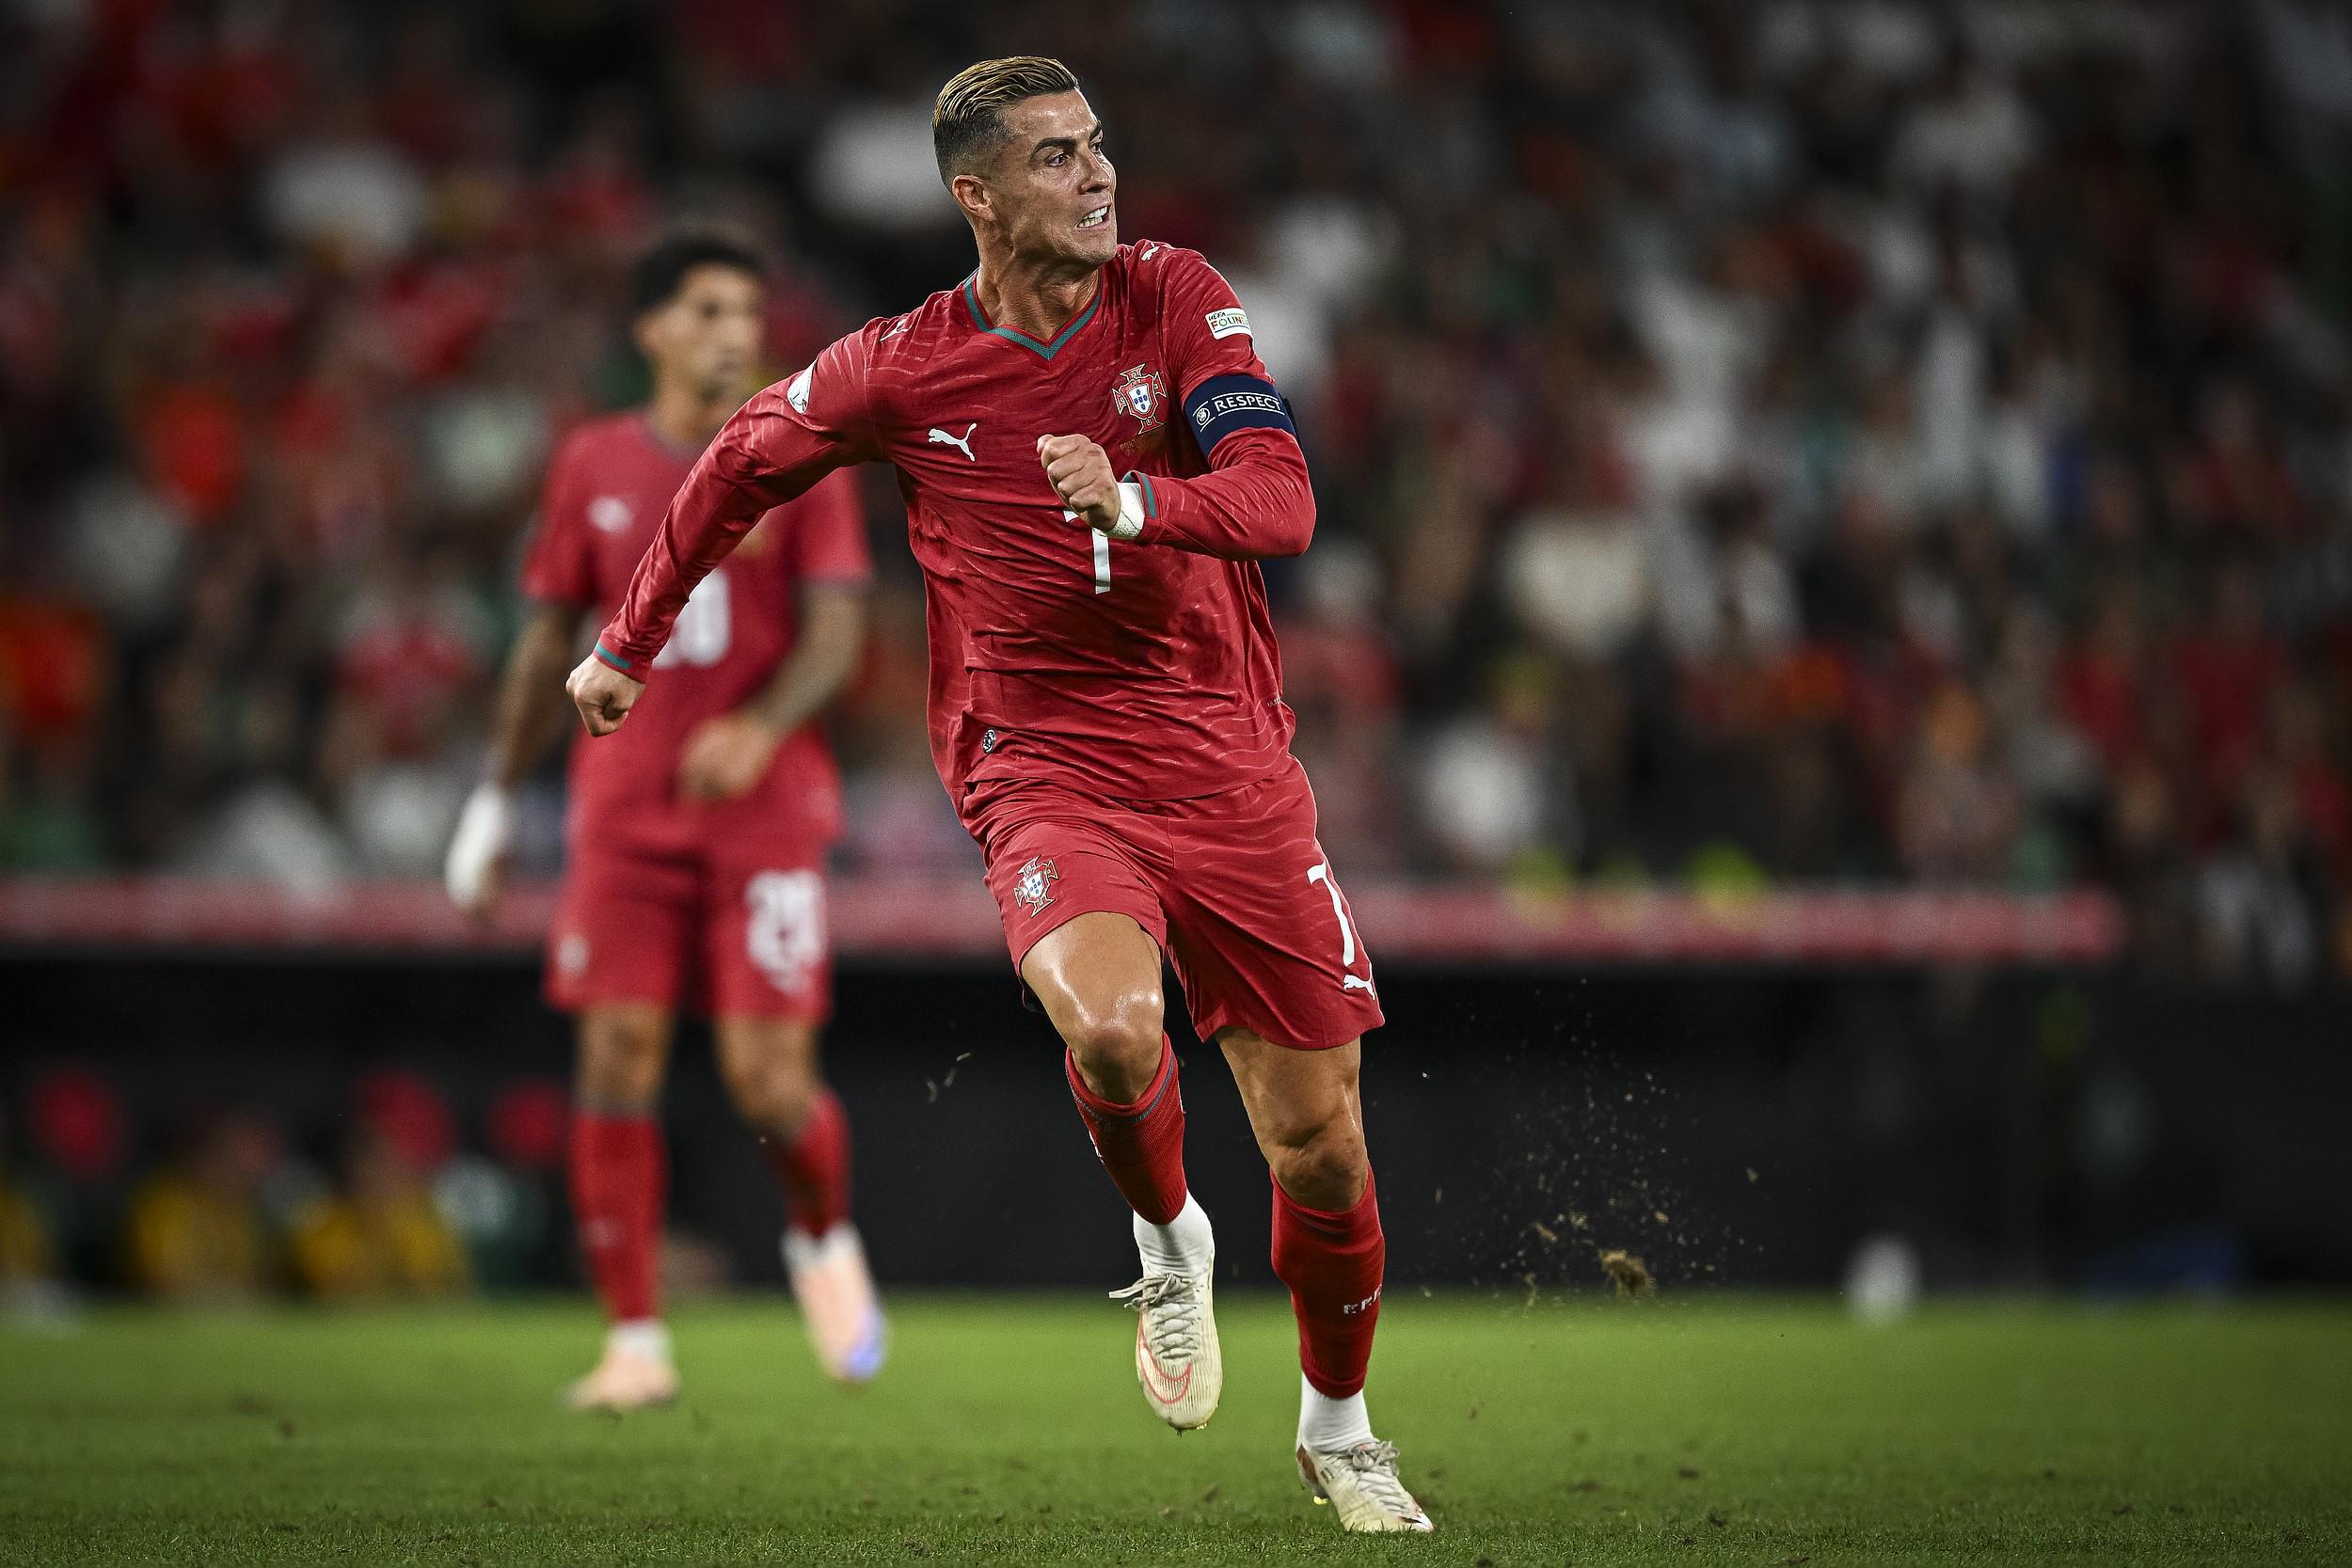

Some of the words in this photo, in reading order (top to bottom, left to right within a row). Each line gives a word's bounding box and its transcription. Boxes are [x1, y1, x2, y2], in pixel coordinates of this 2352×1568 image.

[1209, 311, 1226, 321] UEFA
[1214, 395, 1280, 412] RESPECT
[1307, 860, 1355, 967] 7
